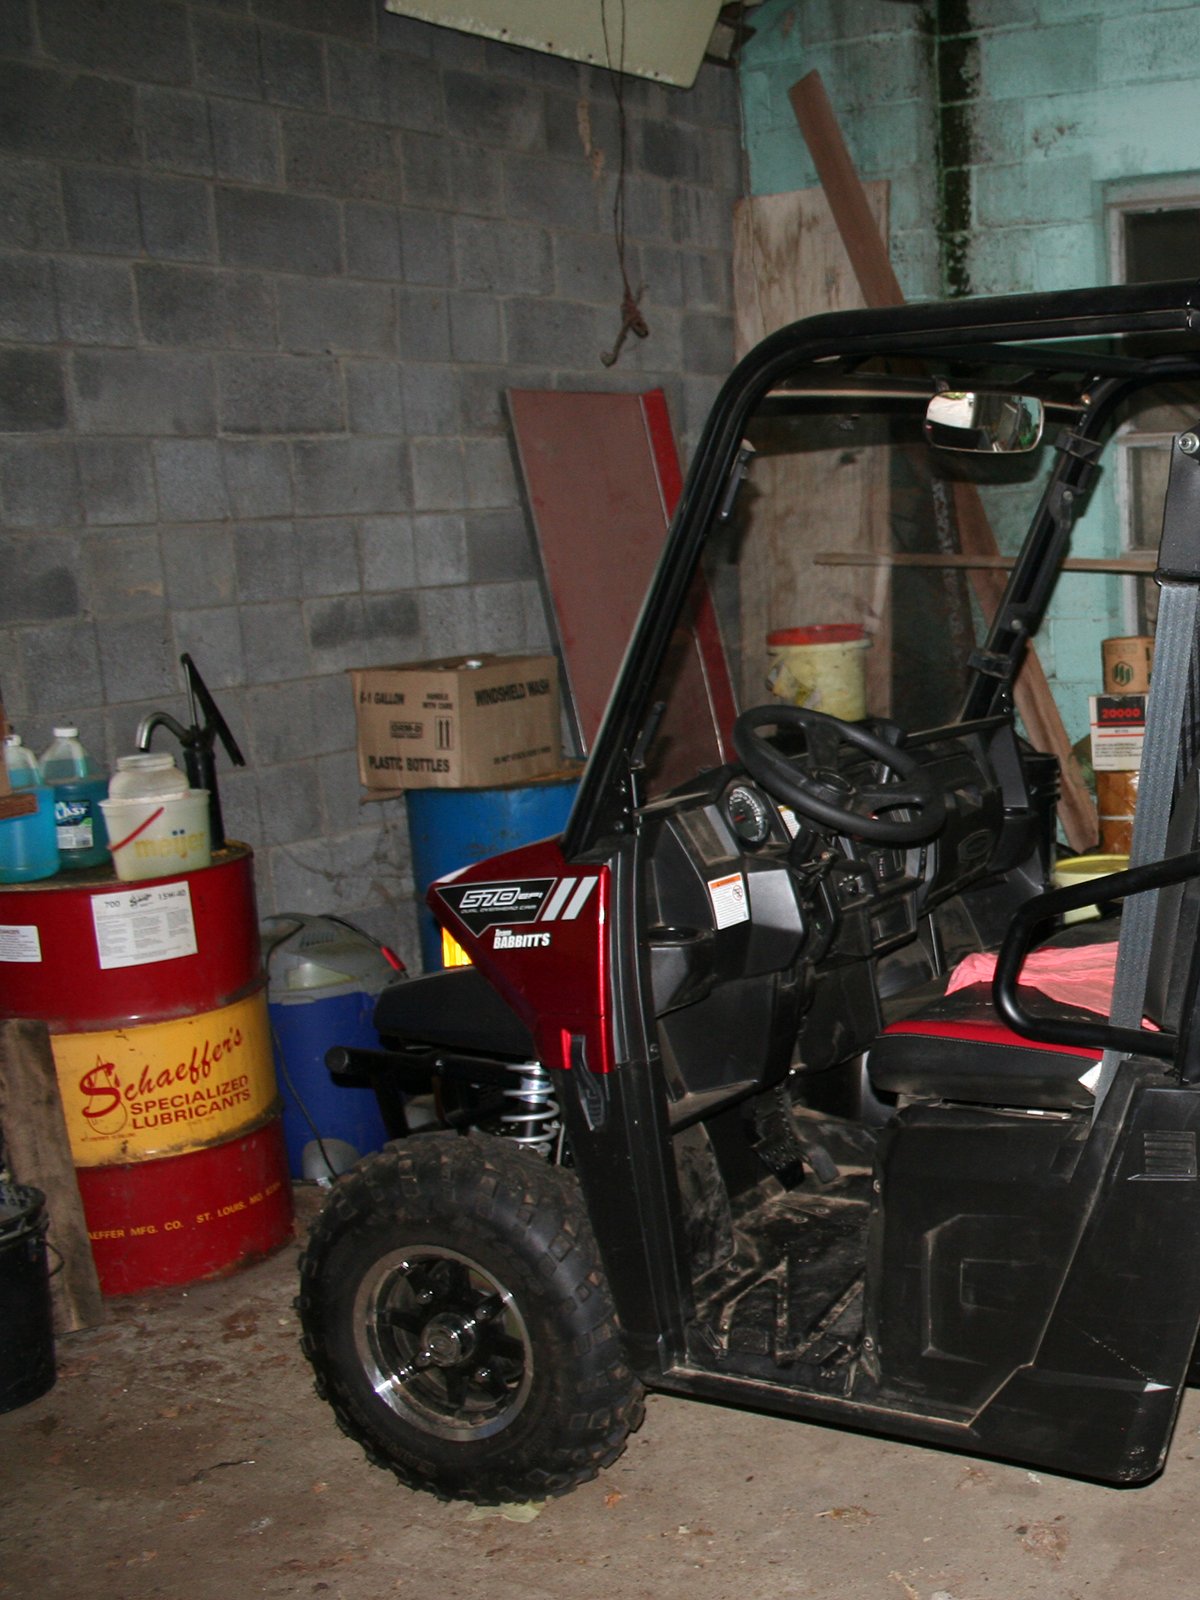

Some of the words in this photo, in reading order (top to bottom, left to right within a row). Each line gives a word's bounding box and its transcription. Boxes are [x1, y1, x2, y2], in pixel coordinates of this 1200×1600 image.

[374, 692, 405, 705] GALLON
[474, 683, 526, 707] WINDSHIELD
[1102, 708, 1141, 719] 20000
[368, 755, 403, 771] PLASTIC
[407, 758, 449, 773] BOTTLES
[133, 829, 206, 859] meijer
[459, 887, 520, 908] 570
[518, 891, 544, 900] EFI
[493, 933, 551, 950] BABBITT'S
[79, 1027, 242, 1119] Schaeffer's
[131, 1075, 248, 1115] SPECIALIZED
[132, 1089, 251, 1130] LUBRICANTS
[164, 1220, 184, 1231] CO.
